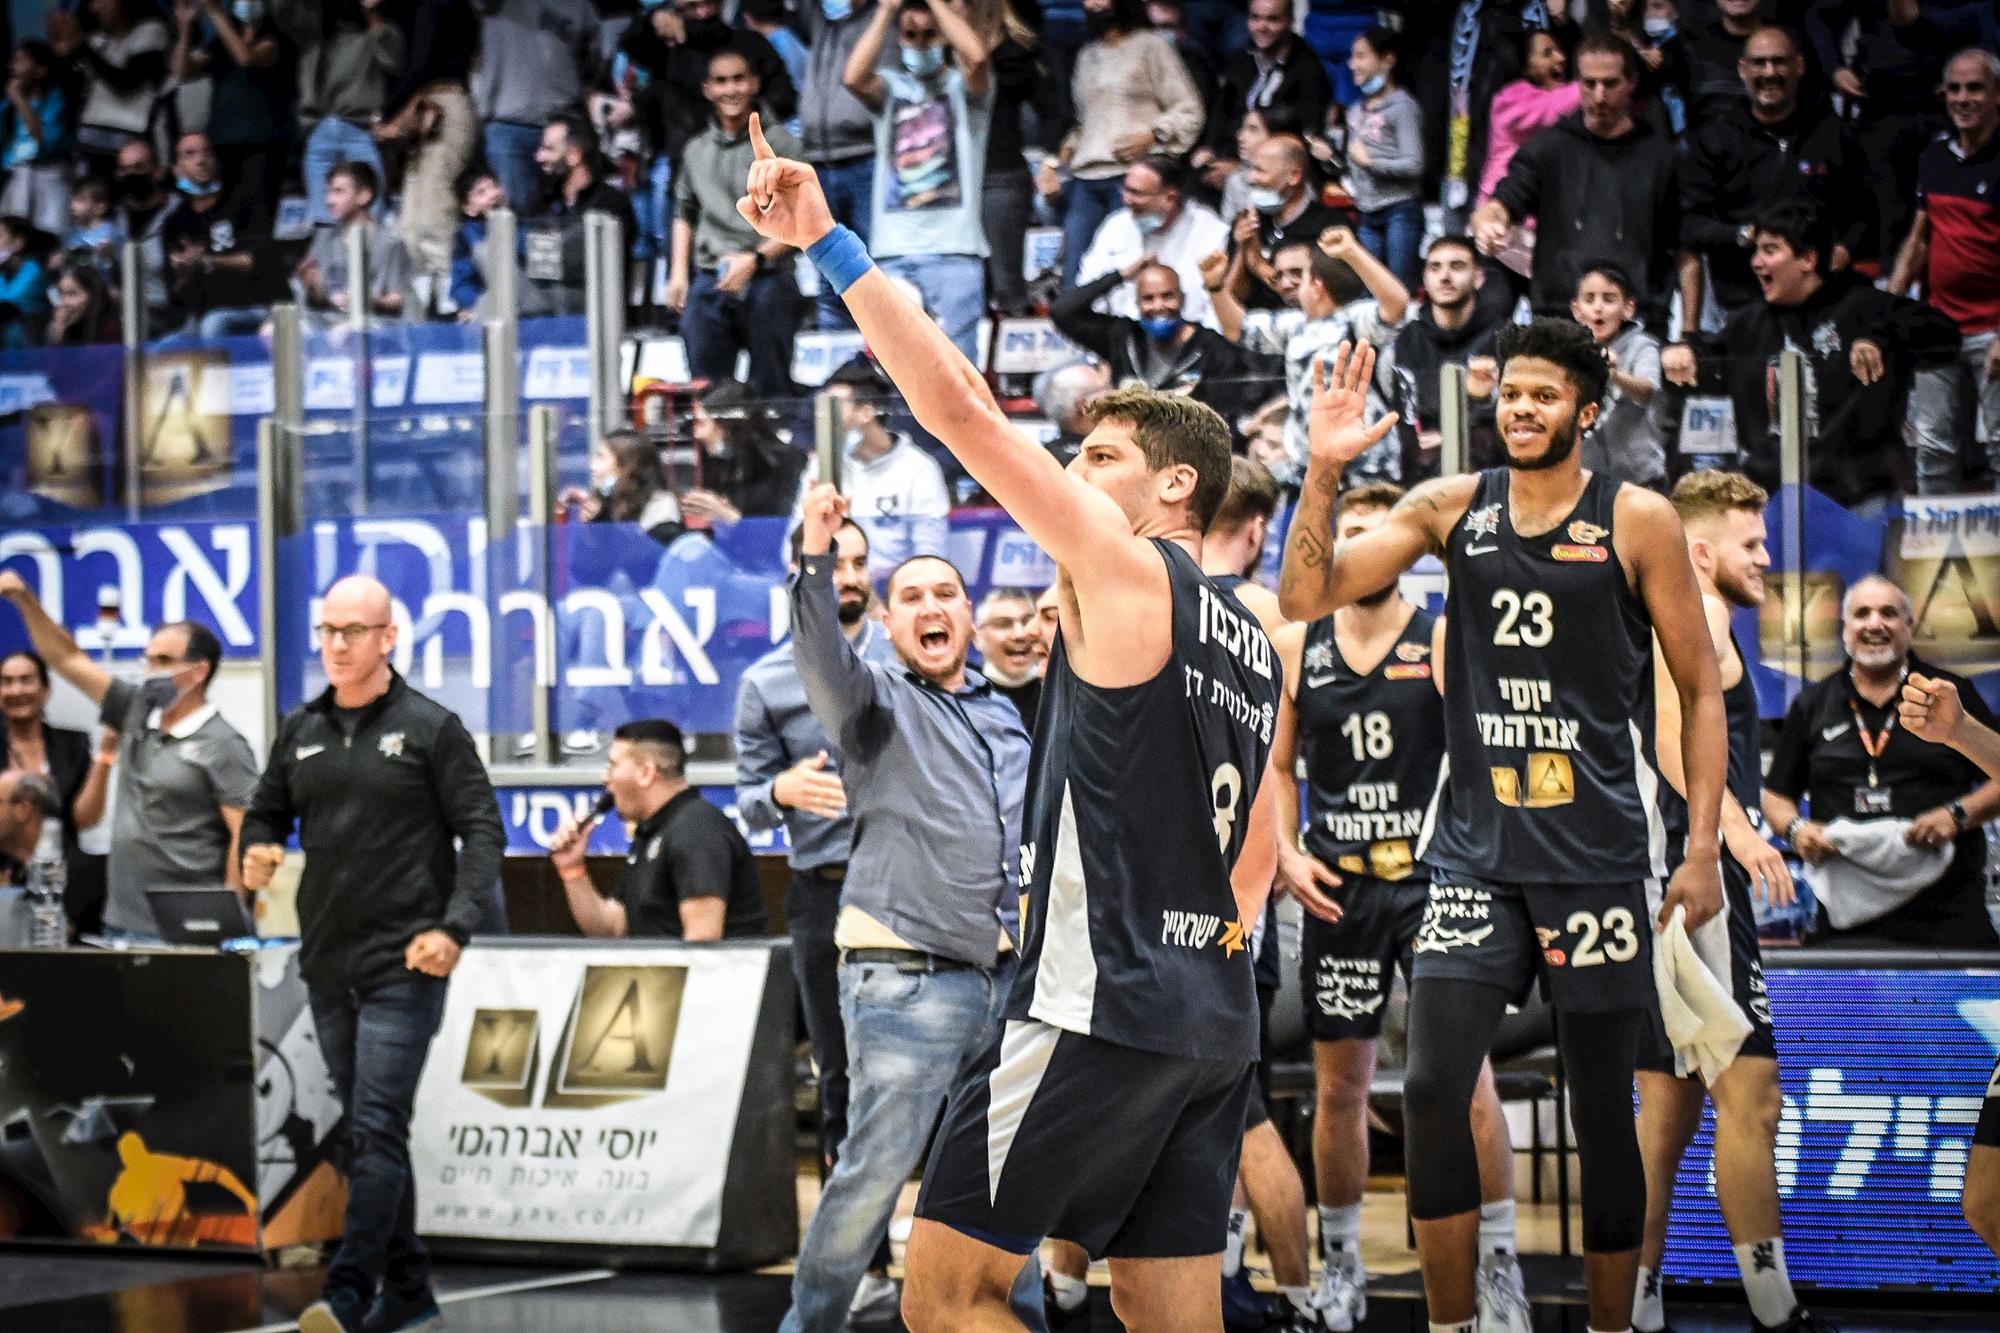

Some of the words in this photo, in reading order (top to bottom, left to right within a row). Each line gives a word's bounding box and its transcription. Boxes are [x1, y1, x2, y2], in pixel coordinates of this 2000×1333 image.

[1491, 588, 1554, 648] 23
[1185, 664, 1203, 698] דן
[1498, 678, 1551, 712] יוסי
[1341, 710, 1393, 761] 18
[1476, 713, 1581, 751] אברהמי
[1348, 782, 1398, 811] יוסי
[1326, 808, 1423, 840] אברהמי
[1566, 906, 1640, 968] 23
[450, 1126, 582, 1159] אברהמי
[598, 1129, 658, 1161] יוסי
[440, 1165, 491, 1186] חיים
[510, 1165, 578, 1189] איכות
[598, 1168, 650, 1191] בונה
